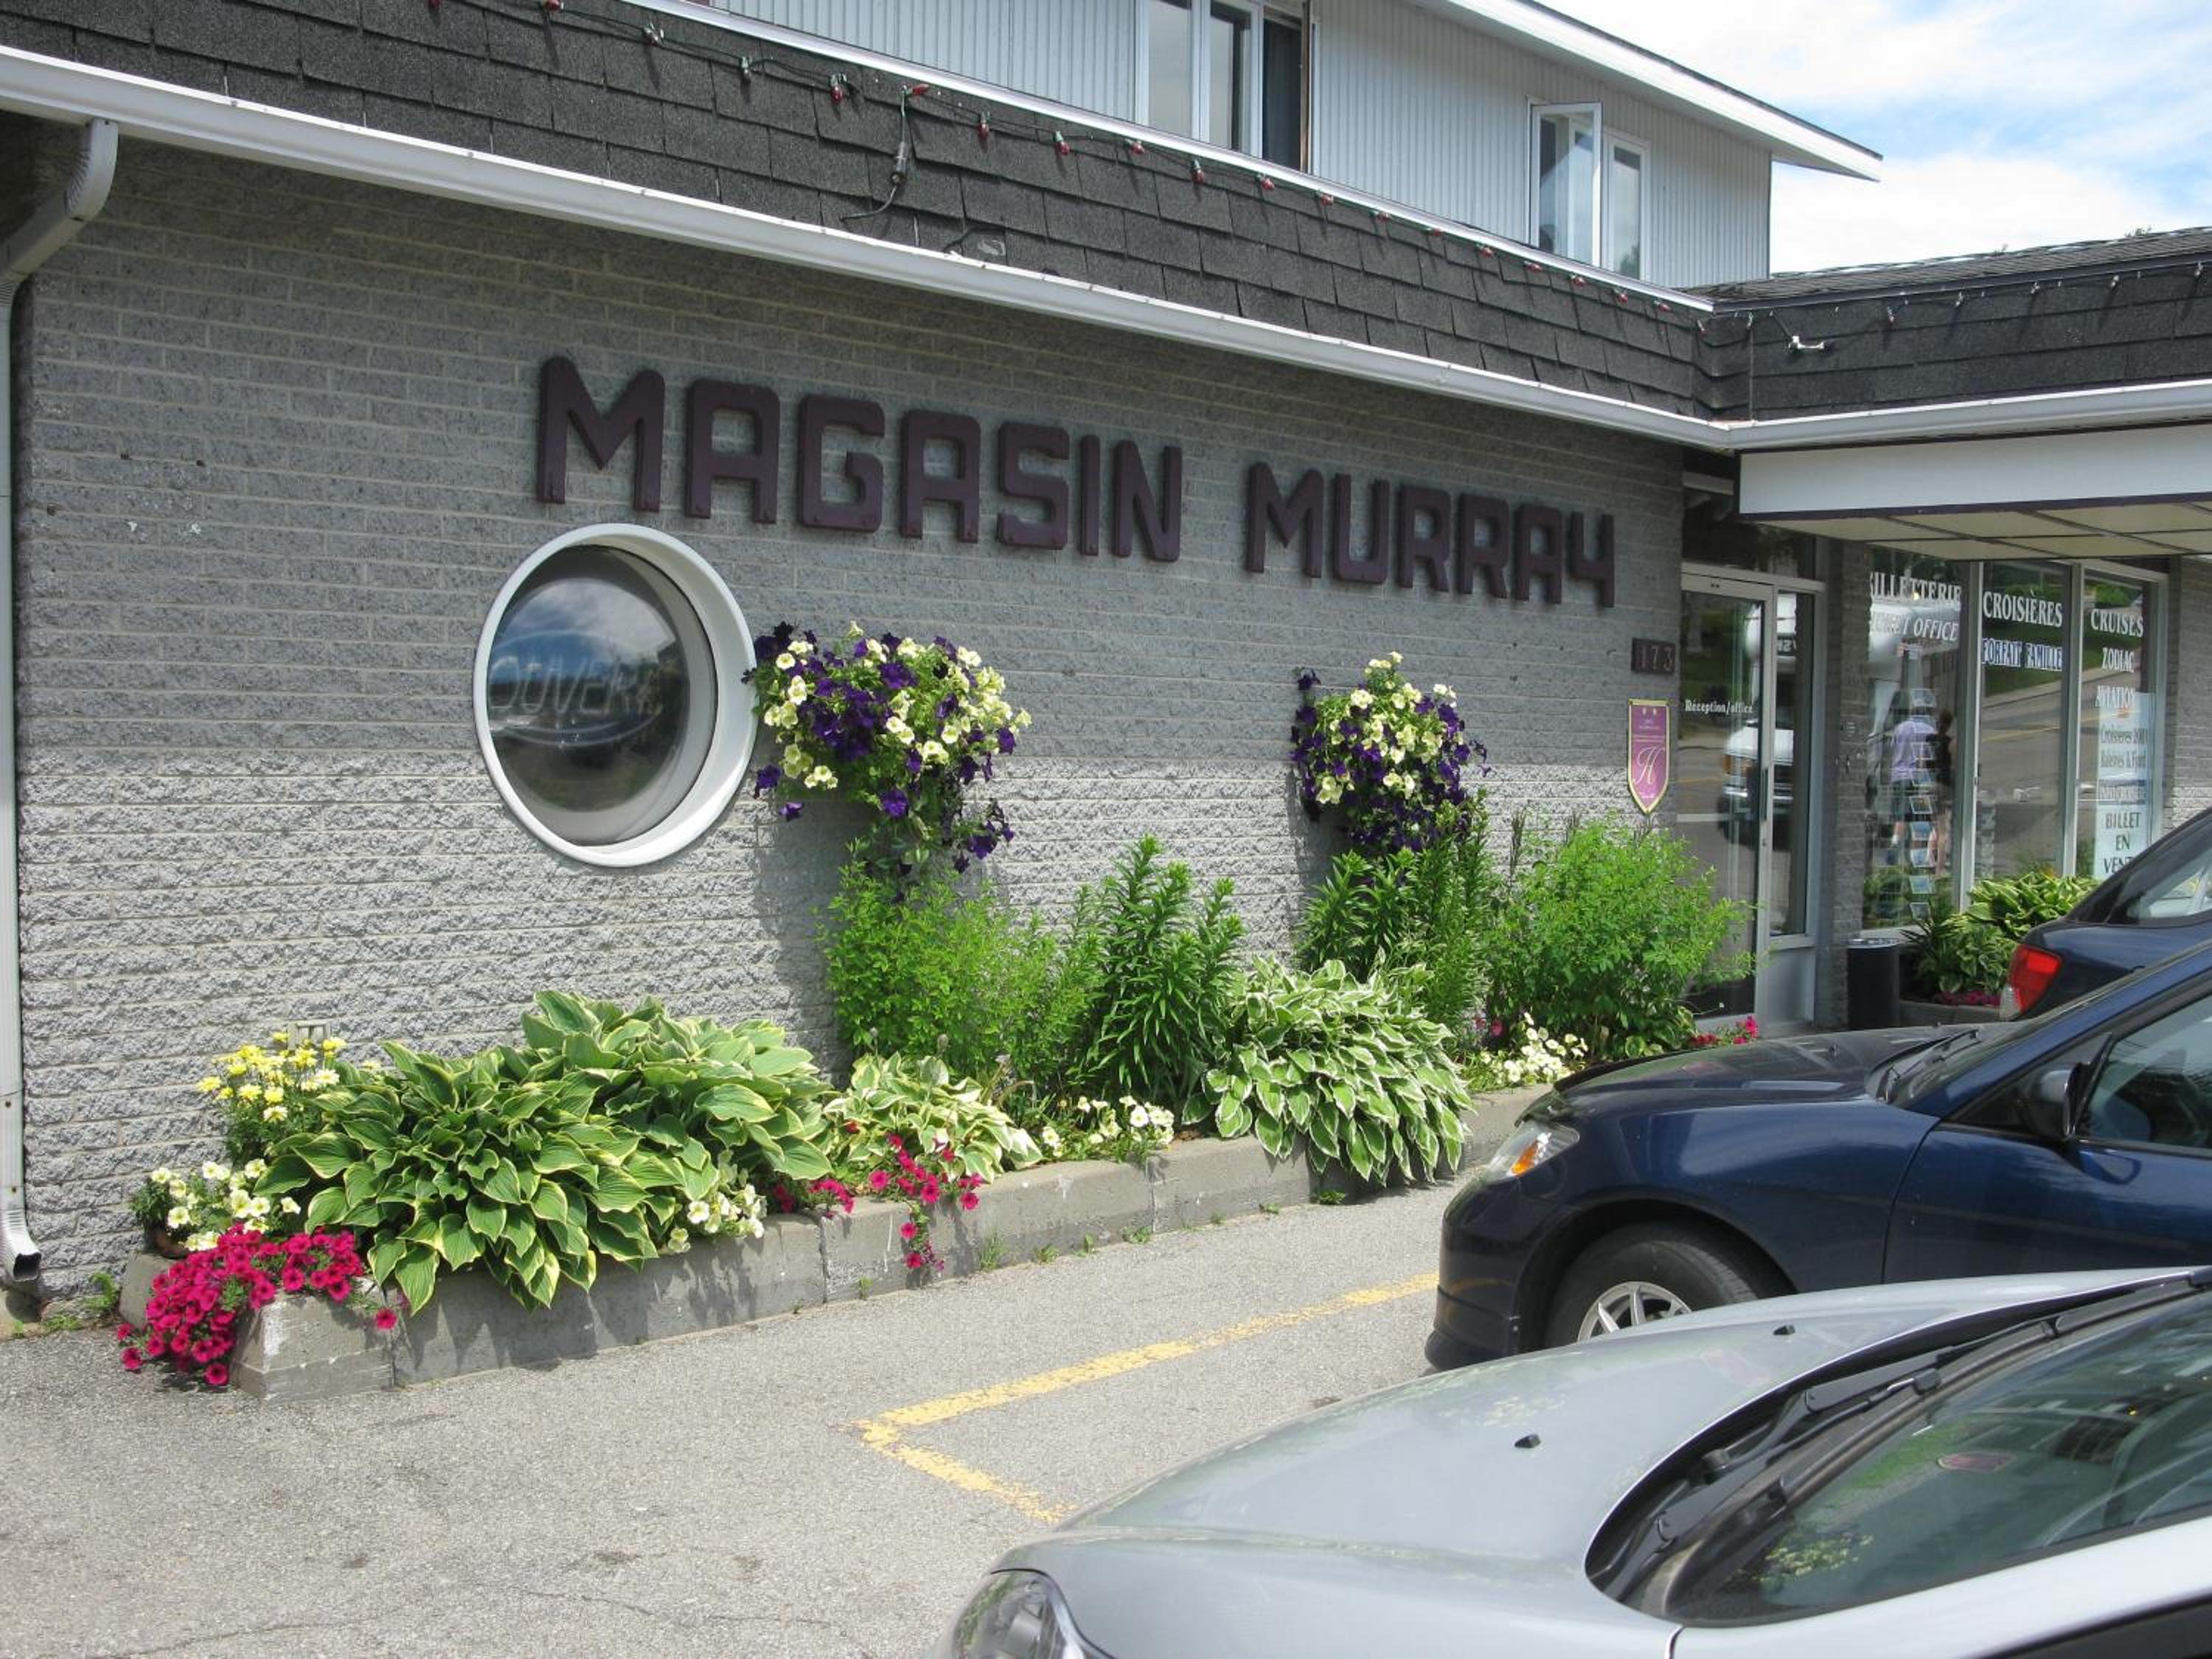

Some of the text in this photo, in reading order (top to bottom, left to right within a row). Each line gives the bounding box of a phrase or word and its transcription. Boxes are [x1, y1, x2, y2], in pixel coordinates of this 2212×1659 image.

[535, 355, 1615, 608] MAGASIN MURRAY
[1983, 590, 2062, 627] CROISIÈRES
[2090, 608, 2143, 637] CRUISES
[1913, 618, 1958, 641] OFFICE
[1640, 644, 1673, 672] 173
[1982, 637, 2062, 672] FORFAIT FAMILLE
[2102, 647, 2135, 673] ZODIAC
[2105, 812, 2140, 830] BILLET
[2115, 834, 2130, 851] EN
